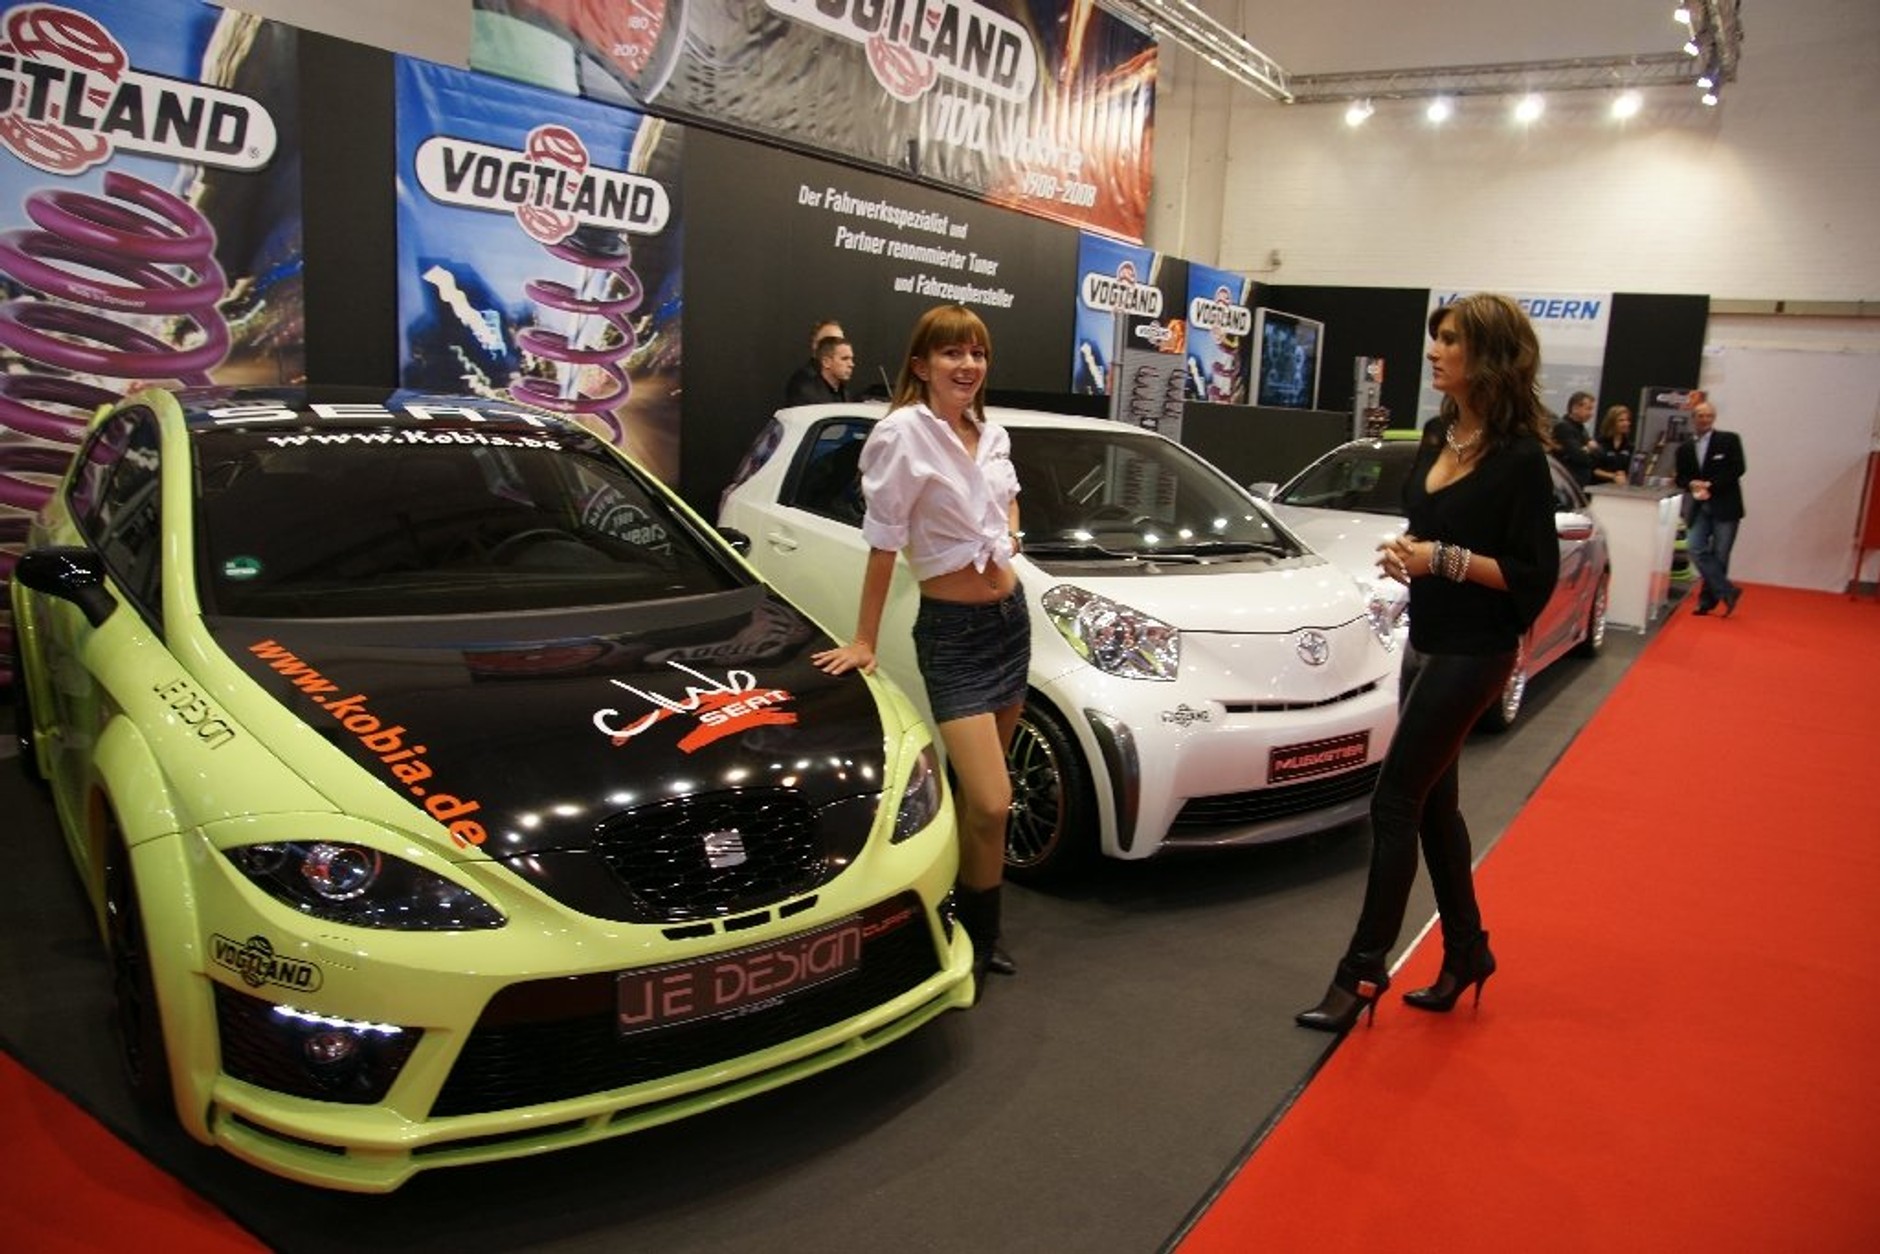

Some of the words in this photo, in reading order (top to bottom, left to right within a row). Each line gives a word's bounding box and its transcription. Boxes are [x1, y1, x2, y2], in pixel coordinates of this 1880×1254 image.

[443, 147, 656, 224] VOGTLAND
[798, 184, 823, 208] Der
[823, 187, 949, 236] Fahrwerksspezialist
[949, 222, 969, 240] und
[834, 226, 887, 256] Partner
[886, 239, 967, 271] renommierter
[968, 252, 999, 277] Tuner
[893, 275, 915, 293] und
[915, 274, 1015, 309] Fahrzeughersteller
[1089, 277, 1158, 314] VOGTLAND
[1196, 300, 1247, 331] VOGTLAND
[207, 403, 548, 428] SEAT
[699, 689, 789, 727] SEAT
[248, 639, 488, 850] www.kobia.de
[214, 938, 312, 987] VOGTLAND
[620, 973, 693, 1024] JE
